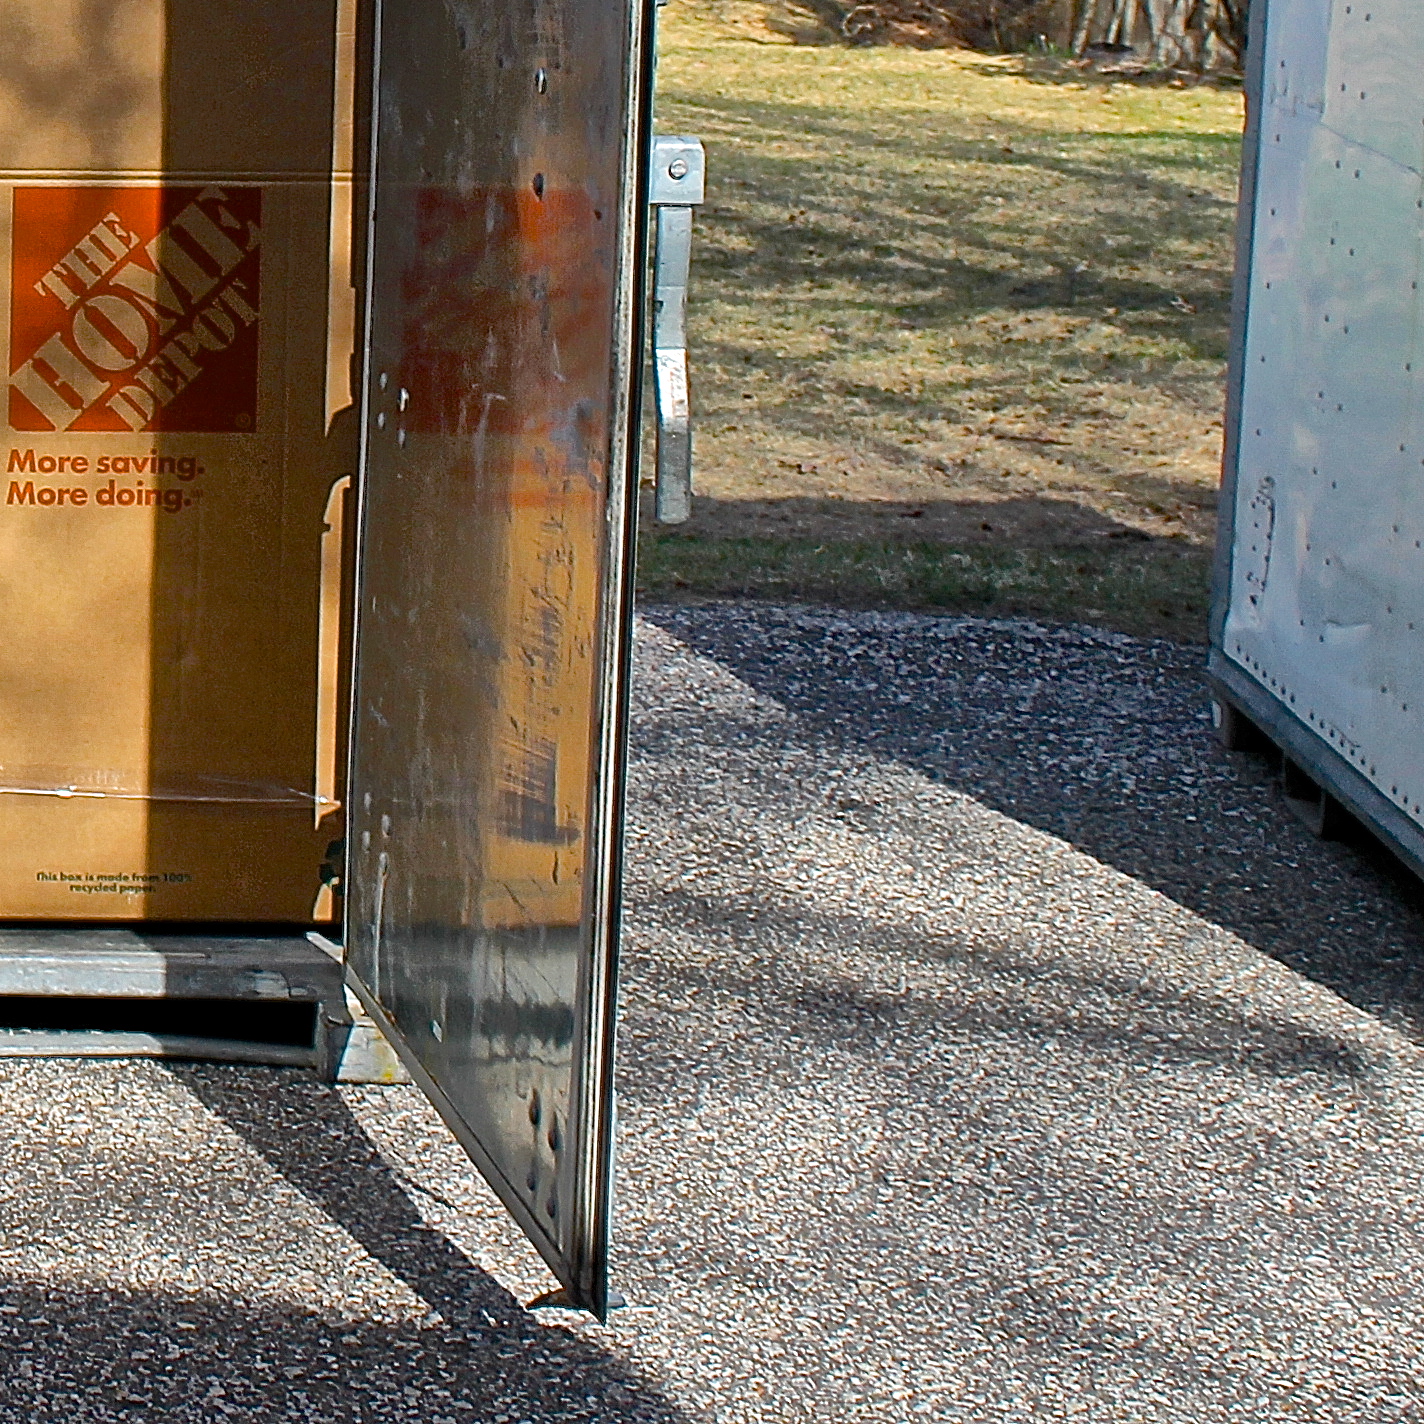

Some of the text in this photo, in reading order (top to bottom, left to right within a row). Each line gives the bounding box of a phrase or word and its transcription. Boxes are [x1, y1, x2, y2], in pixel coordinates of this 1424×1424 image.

[9, 186, 262, 433] HOME
[33, 210, 141, 311] THE
[105, 277, 261, 433] DEPOT
[6, 481, 192, 512] More doing.
[7, 449, 206, 480] More saving.
